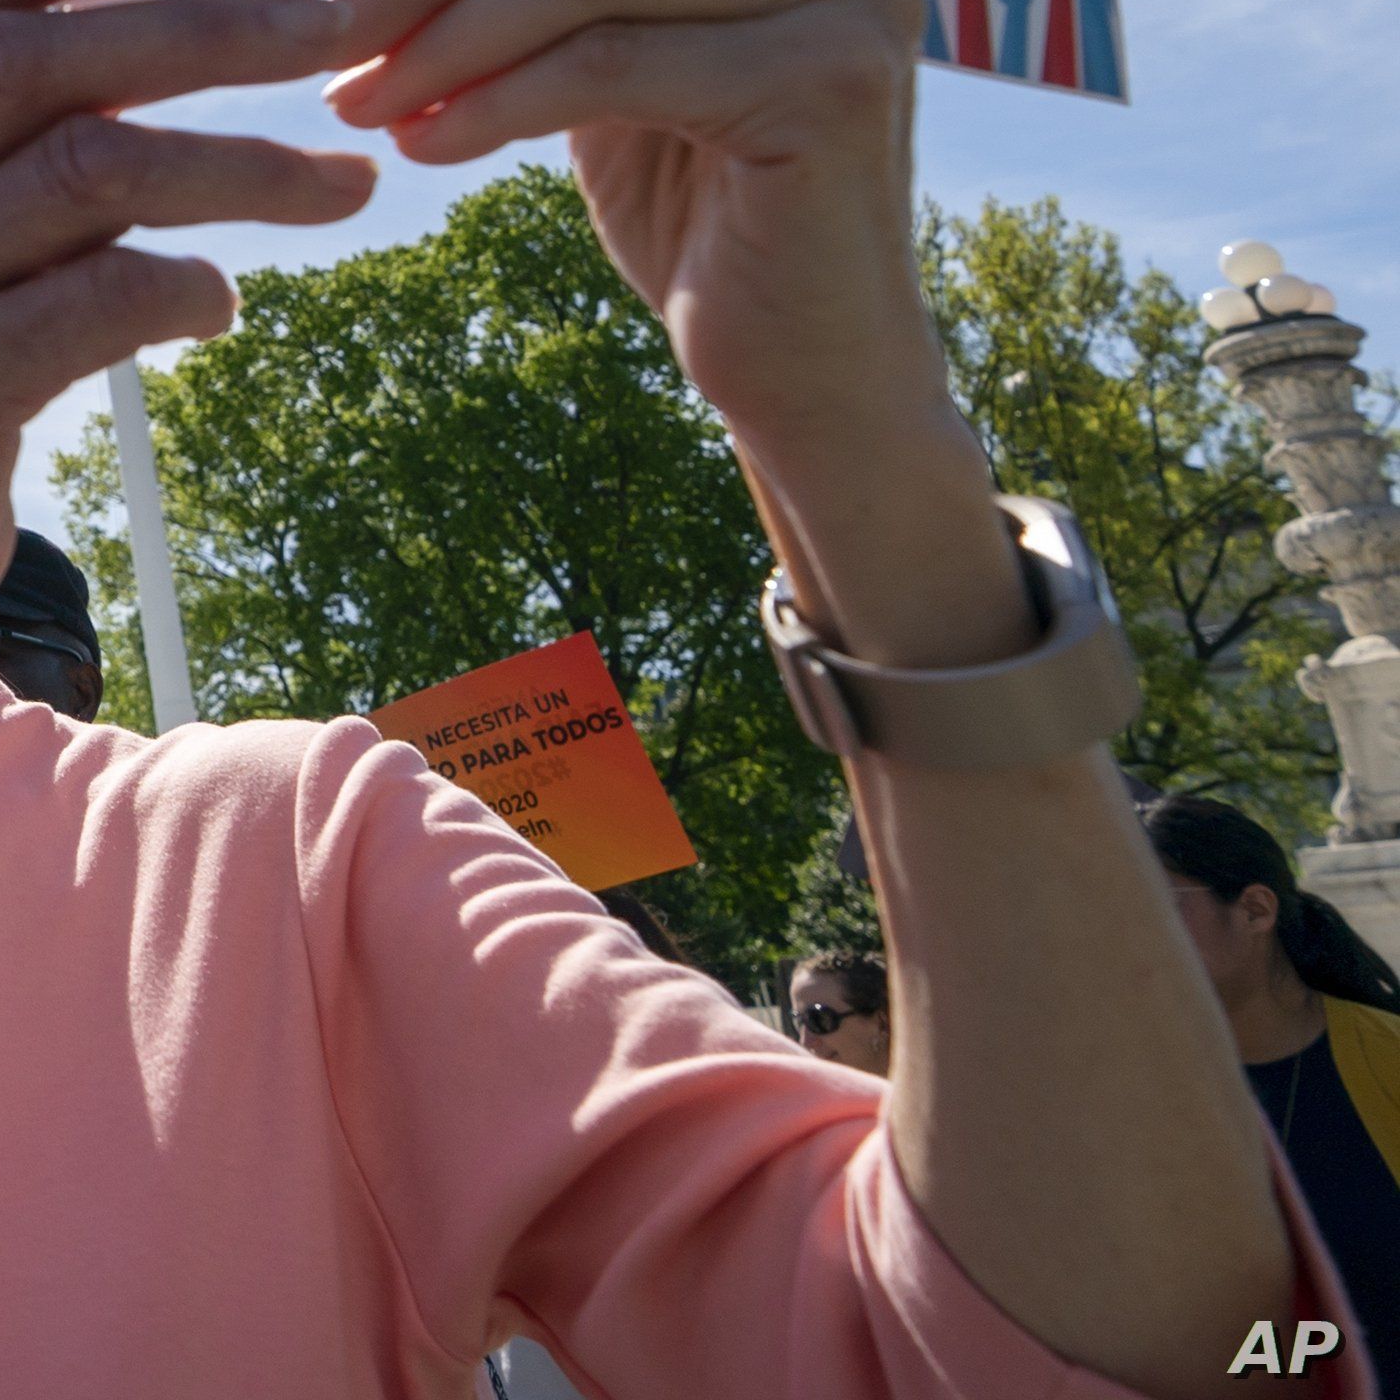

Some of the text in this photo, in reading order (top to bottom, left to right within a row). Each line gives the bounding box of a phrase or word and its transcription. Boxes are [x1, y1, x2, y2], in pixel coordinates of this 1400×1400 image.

[424, 687, 571, 752] NECESITA UN
[460, 737, 533, 775] PARA
[531, 706, 625, 752] TODOS
